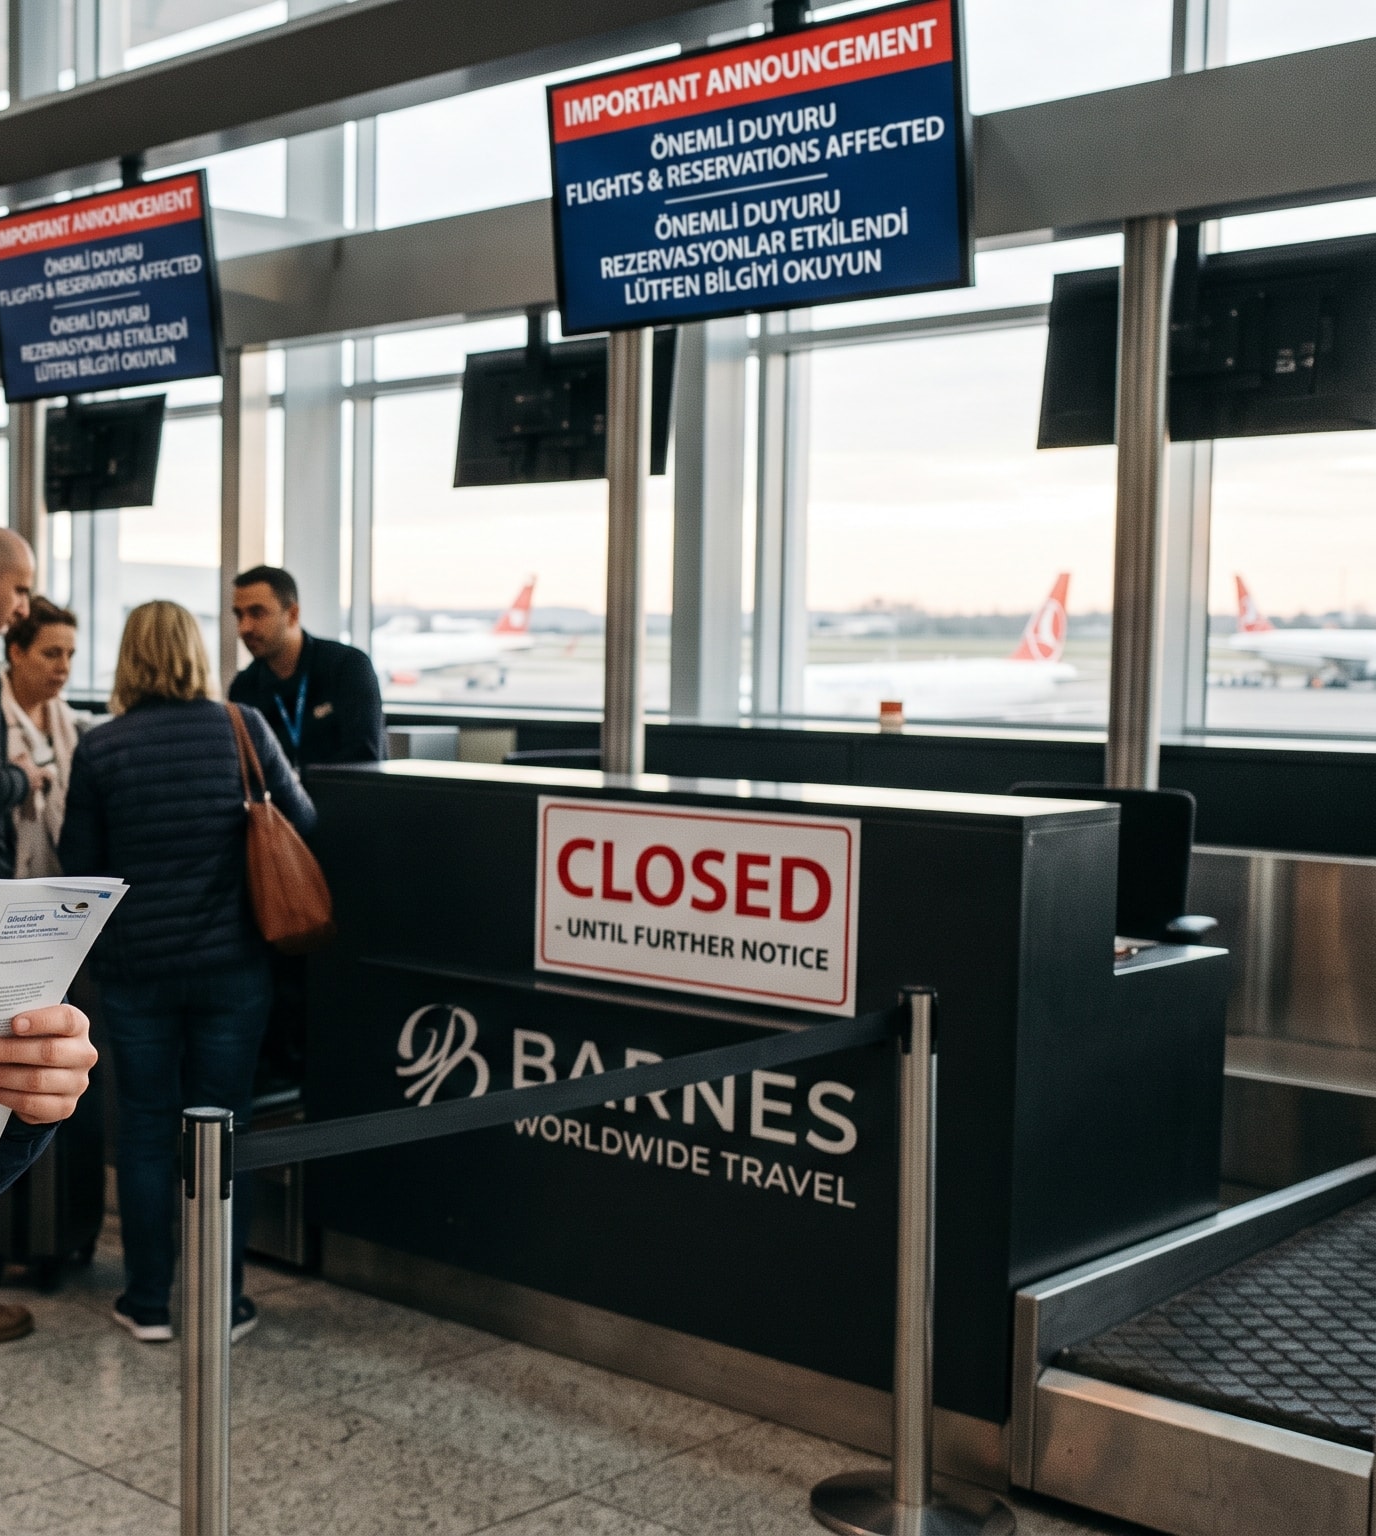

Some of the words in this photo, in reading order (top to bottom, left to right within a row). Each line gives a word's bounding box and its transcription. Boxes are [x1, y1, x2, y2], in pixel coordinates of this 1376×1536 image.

[564, 73, 701, 127] IMPORTANT
[706, 20, 937, 96] ANNOUNCEMENT
[651, 119, 734, 161] ÖNEMLİ
[740, 103, 837, 143] DUYURU
[566, 172, 642, 206] FLIGHTS
[647, 169, 663, 191] &
[668, 139, 821, 188] RESERVATIONS
[826, 116, 944, 159] AFFECTED
[72, 187, 193, 233] ANNOUNCEMENT
[655, 202, 739, 240] ÖNEMLİ
[744, 190, 840, 229] DUYURU
[44, 249, 89, 277] ÖNEMLİ
[92, 243, 143, 269] DUYURU
[601, 231, 786, 279] REZERVASYONLAR
[791, 207, 908, 251] ETKİLENDİ
[0, 284, 44, 307] FLIGHTS
[56, 267, 136, 297] RESERVATIONS
[139, 254, 202, 281] AFFECTED
[625, 274, 700, 305] LÜTFEN
[705, 258, 779, 296] BİLGİYİ
[783, 250, 882, 284] OKUYUN
[21, 331, 122, 362] REZERVASYONLAR
[50, 309, 95, 336] ÖNEMLİ
[97, 304, 150, 328] DUYURU
[35, 360, 77, 383] LÜTFEN
[122, 347, 176, 370] OKUYUN
[556, 838, 832, 923] CLOSED
[567, 918, 627, 945] UNTIL
[634, 925, 734, 959] FURTHER
[741, 940, 828, 971] NOTICE
[513, 1029, 858, 1154] BARNES
[514, 1116, 710, 1176] WORLDWIDE
[721, 1151, 855, 1209] TRAVEL
